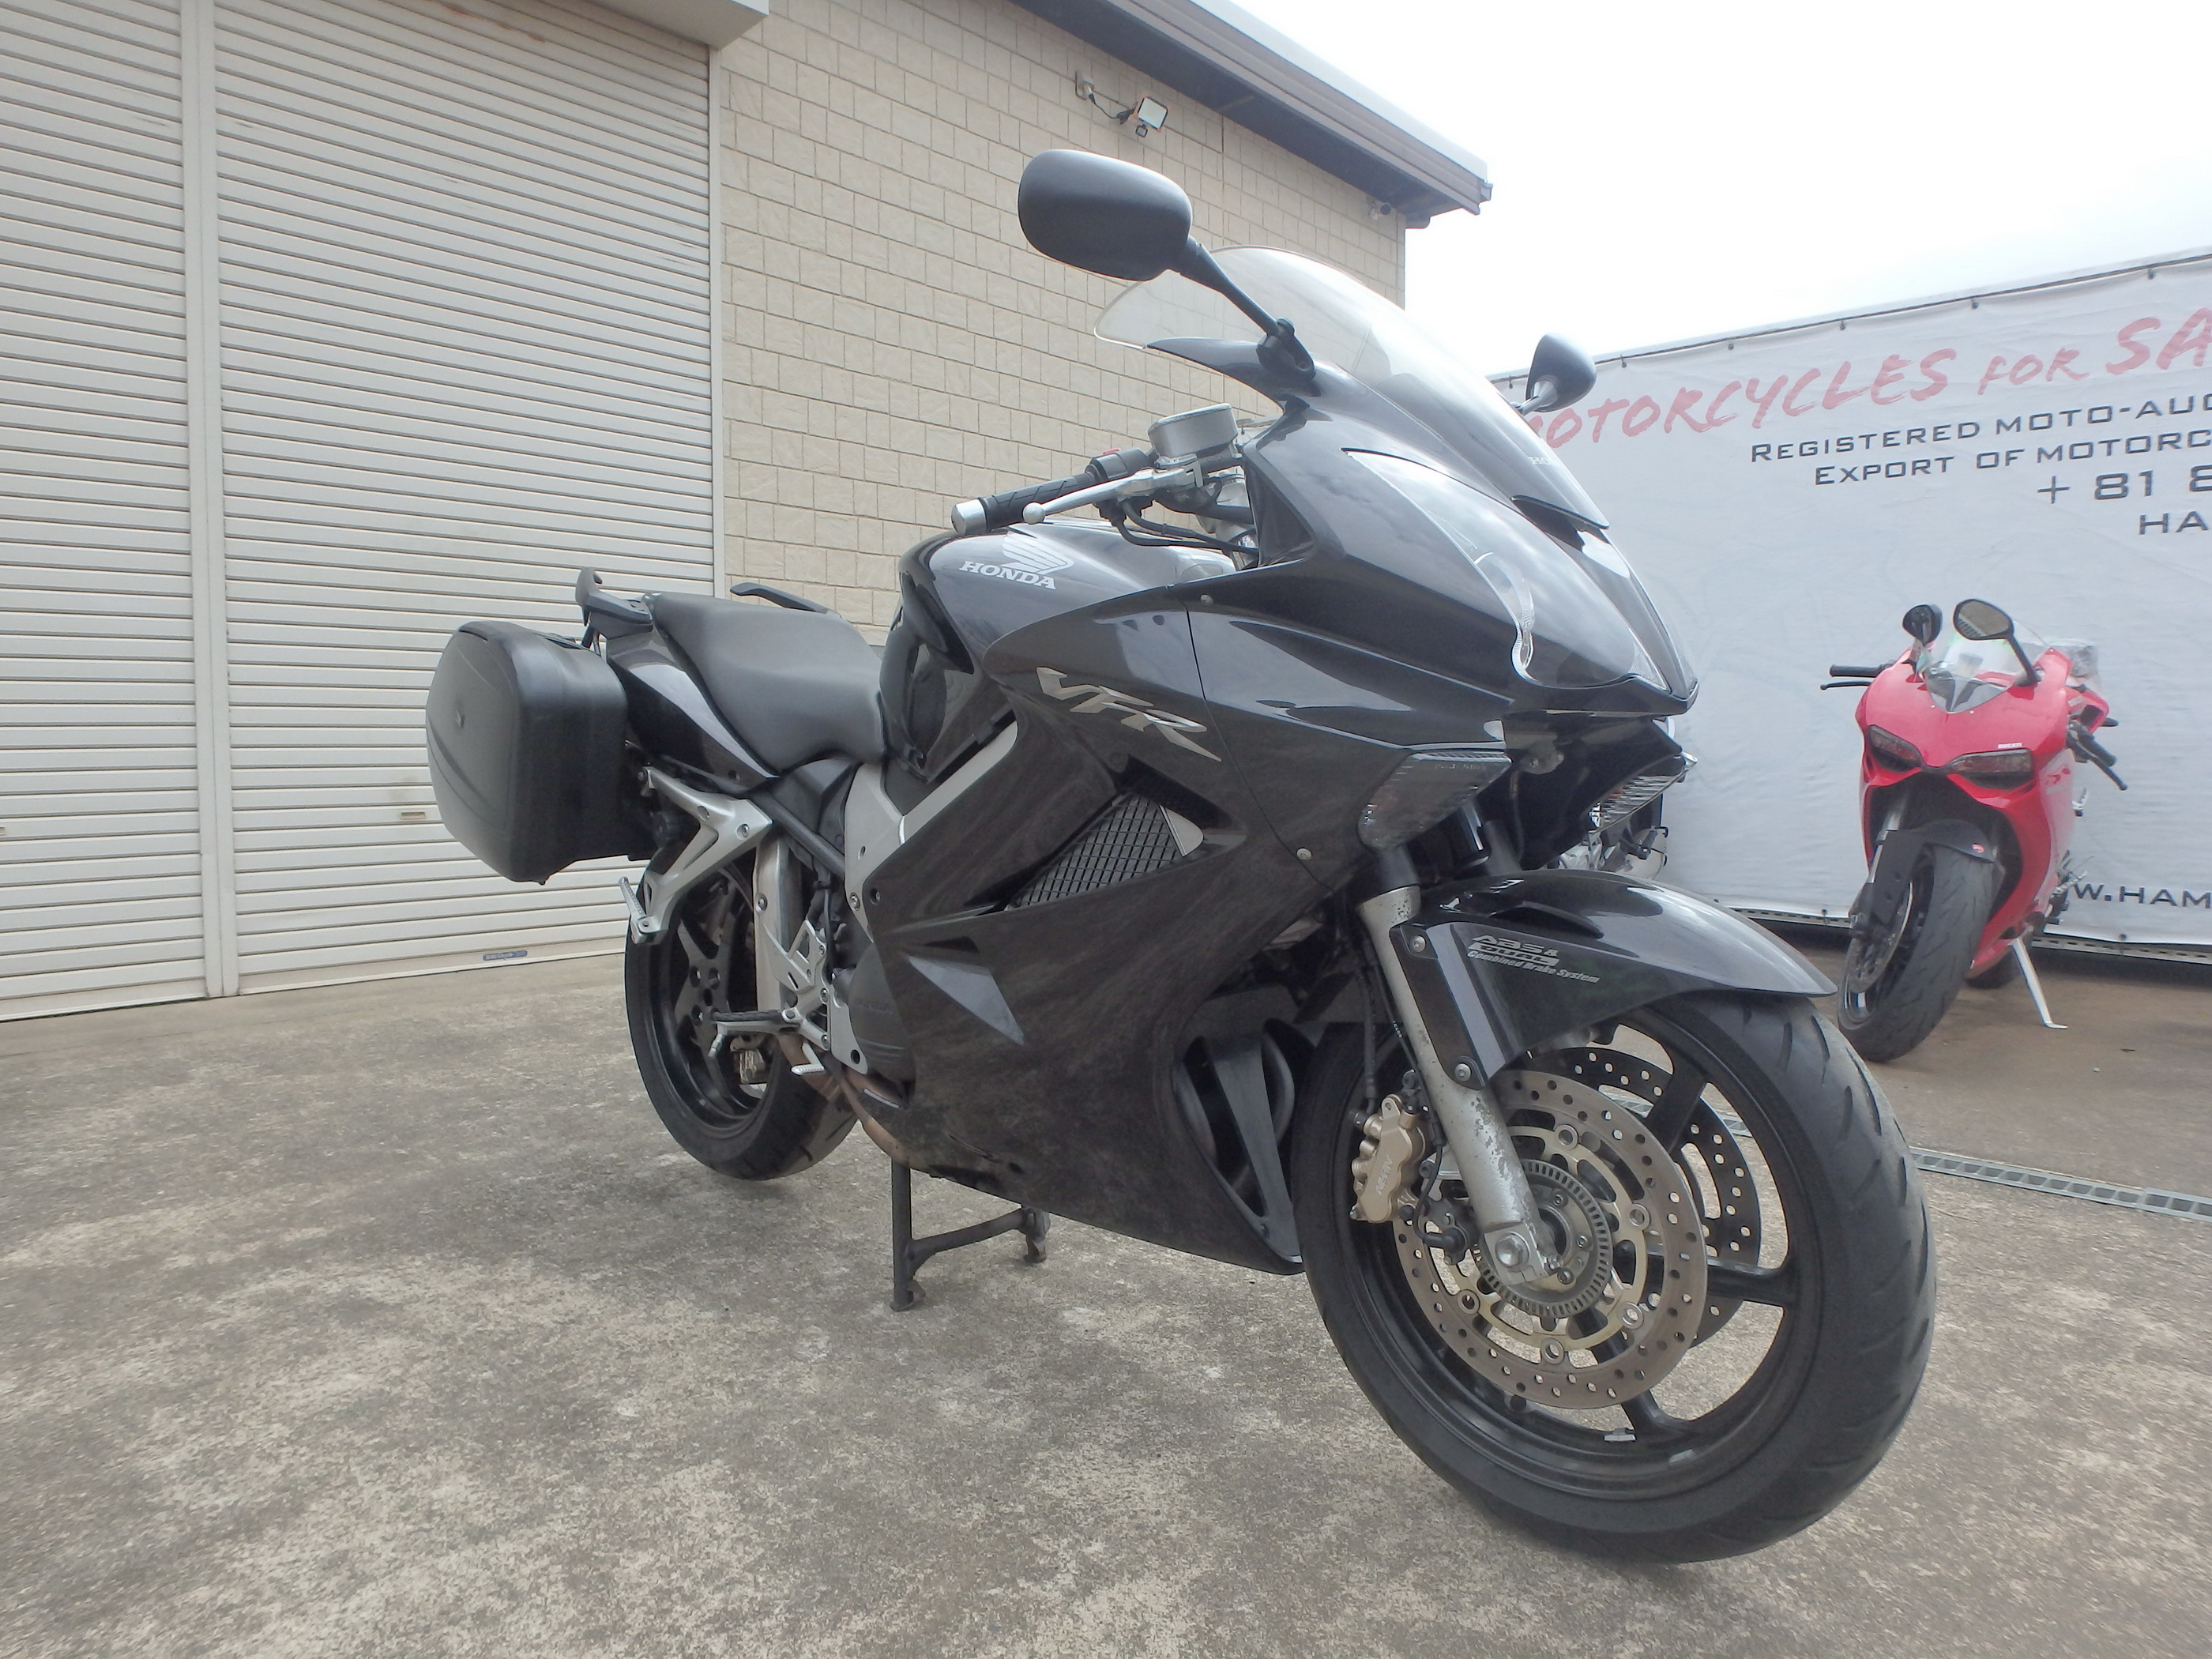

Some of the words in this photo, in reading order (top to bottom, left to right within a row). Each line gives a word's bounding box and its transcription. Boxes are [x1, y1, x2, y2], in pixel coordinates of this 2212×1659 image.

[1751, 421, 1980, 463] REGISTERED
[1815, 455, 1955, 487] EXPORT
[1977, 449, 2025, 469] OF
[2037, 429, 2211, 465] MOTORC
[2094, 470, 2154, 501] 81
[958, 560, 1056, 590] HONDA
[1472, 935, 1545, 954] ABS
[1467, 950, 1525, 968] Combined
[1522, 961, 1557, 975] Brake
[1556, 969, 1601, 984] System
